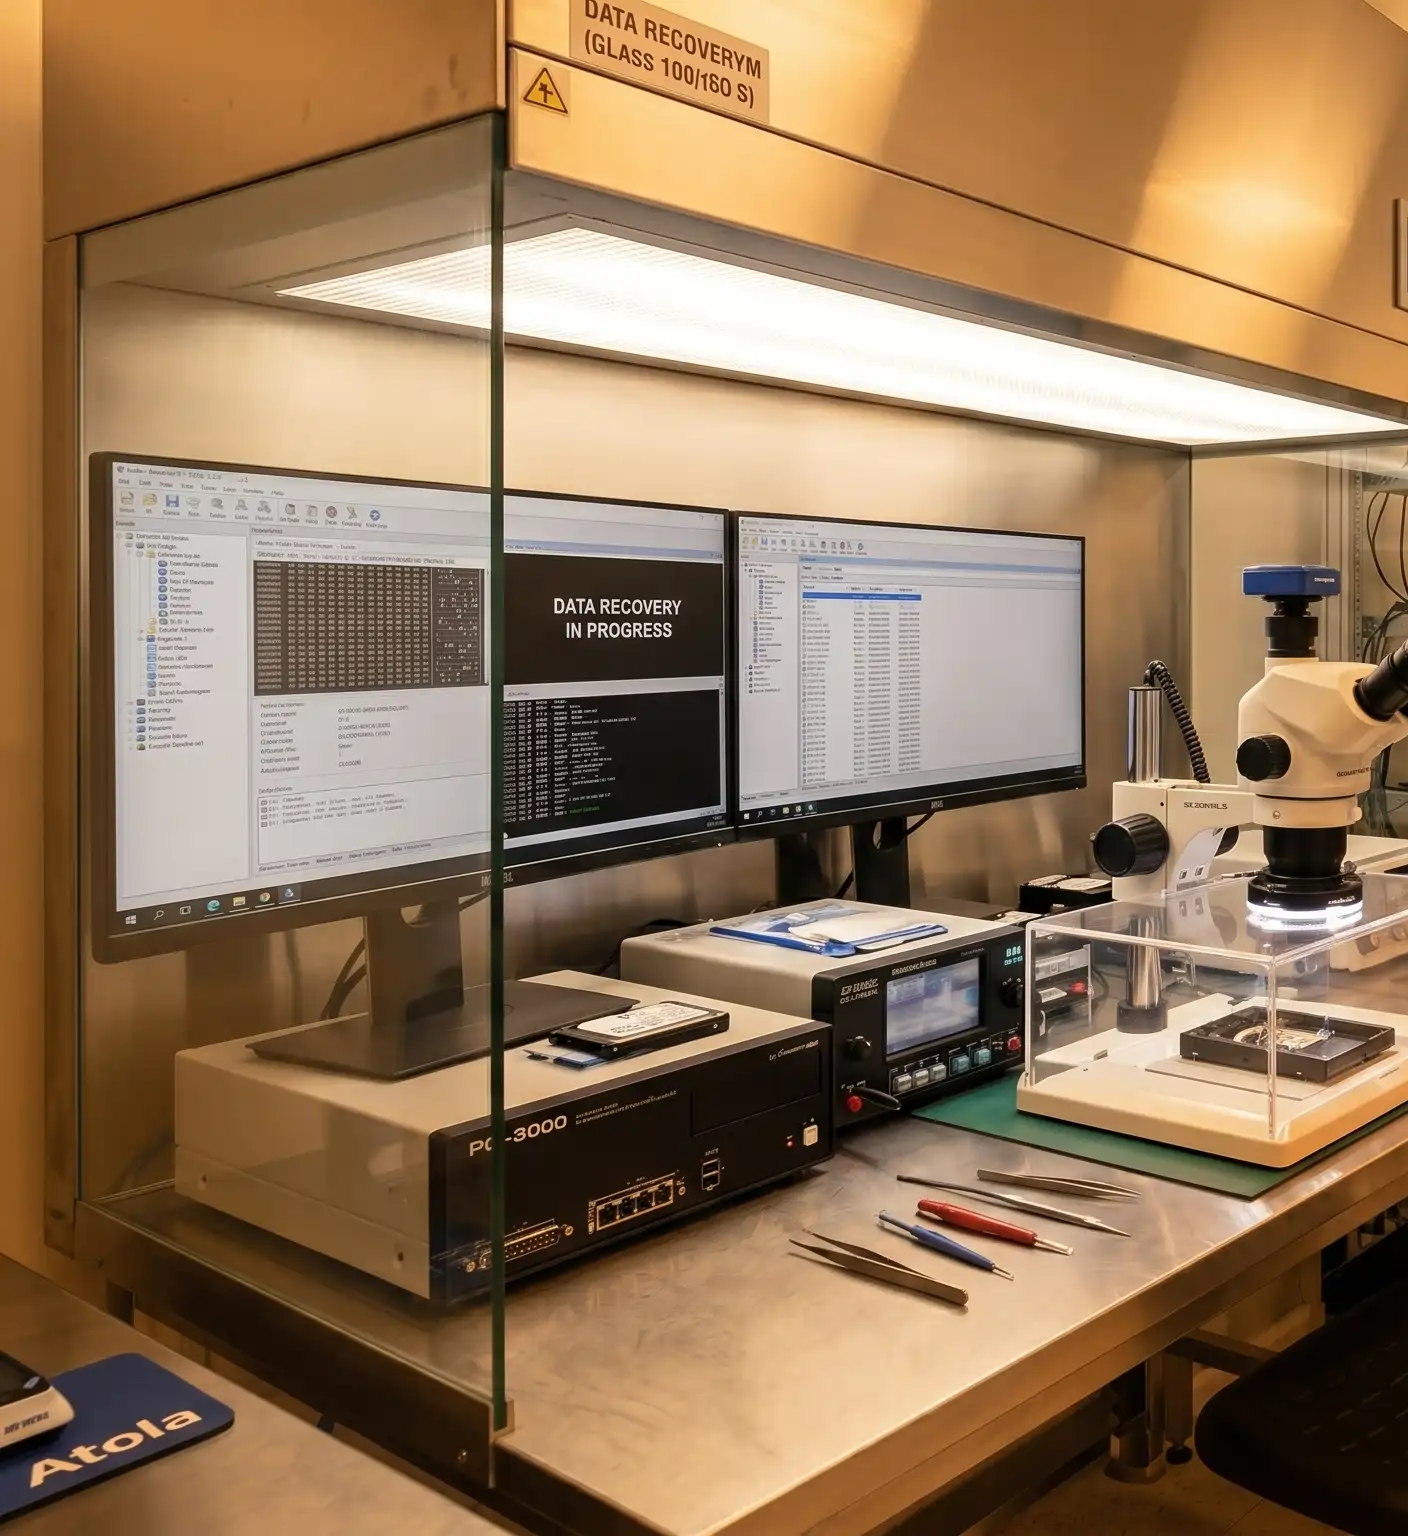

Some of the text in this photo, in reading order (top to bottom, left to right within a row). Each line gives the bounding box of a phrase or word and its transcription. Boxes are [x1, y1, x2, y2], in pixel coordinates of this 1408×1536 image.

[585, 0, 761, 80] DATA RECOVERYM
[585, 29, 654, 72] (GLASS
[737, 83, 754, 110] S)
[553, 597, 682, 616] DATA RECOVERY
[566, 621, 673, 639] IN PROGRESS
[29, 1410, 202, 1489] Atola
